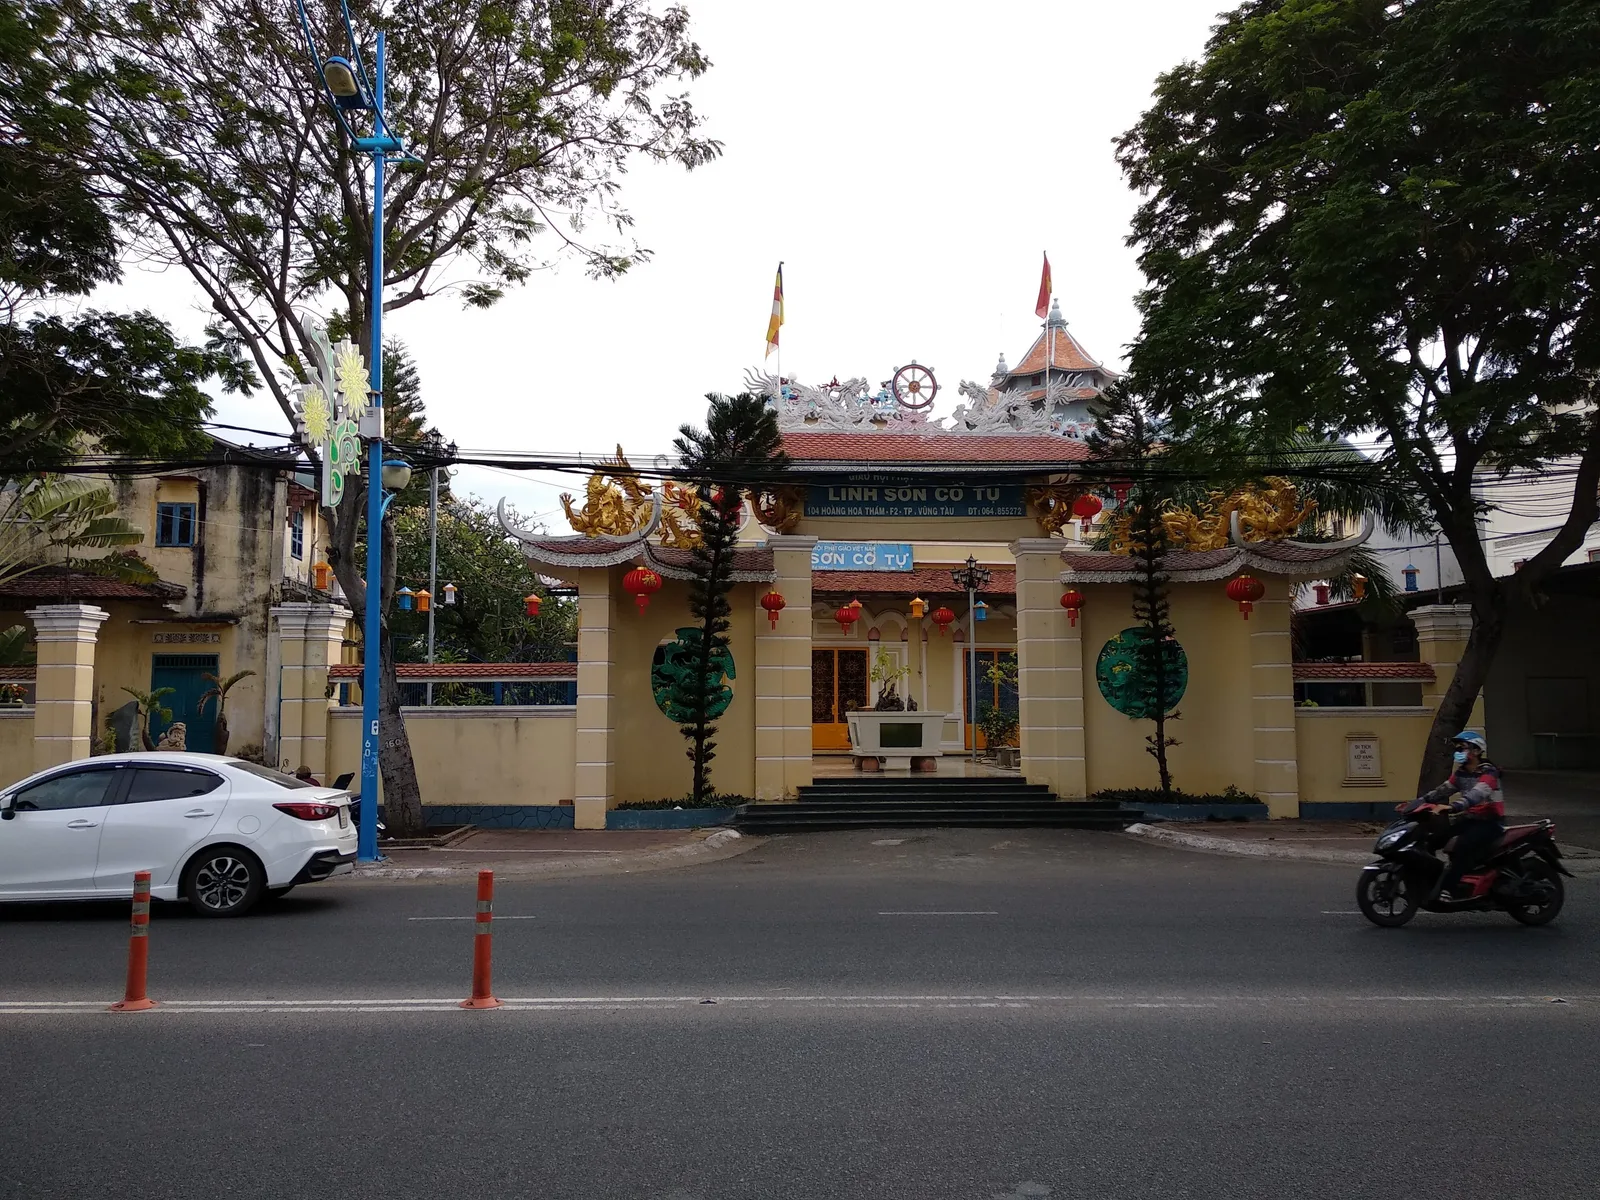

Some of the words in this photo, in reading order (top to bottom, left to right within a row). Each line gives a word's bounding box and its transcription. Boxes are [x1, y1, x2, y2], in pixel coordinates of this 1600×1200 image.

[828, 487, 878, 501] LINH
[807, 506, 820, 516] 104
[821, 504, 846, 516] HOÀNG
[811, 552, 845, 565] SƠN
[884, 552, 909, 569] TỰ
